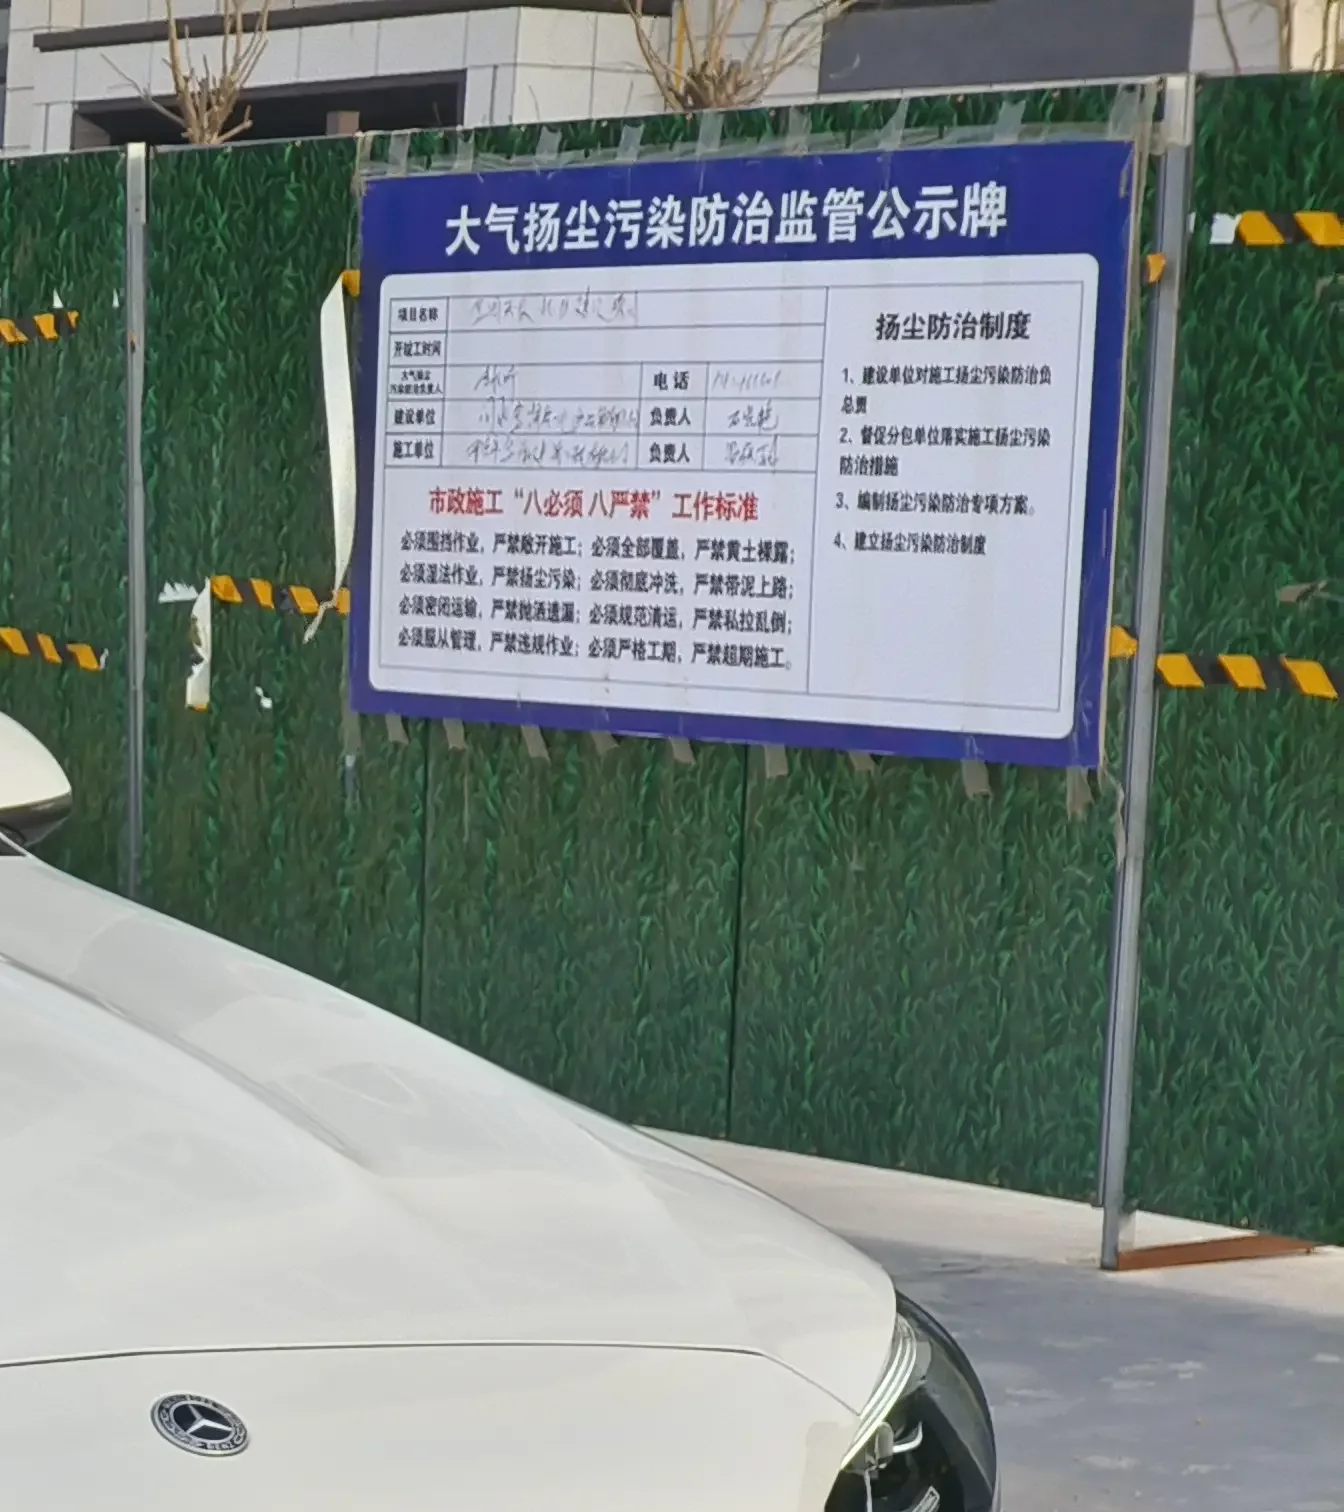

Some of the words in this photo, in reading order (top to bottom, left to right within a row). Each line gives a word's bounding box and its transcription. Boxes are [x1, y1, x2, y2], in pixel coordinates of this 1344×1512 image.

[445, 180, 1008, 256] 大气扬尘污染防治监管公示牌
[398, 307, 439, 322] 项目名称
[876, 310, 1031, 341] 扬尘防治制度
[653, 371, 689, 391] 电话
[394, 408, 436, 425] 建设单位
[650, 407, 691, 427] 负责人
[393, 439, 434, 460] 施工单位
[649, 442, 690, 463] 负责人
[839, 455, 899, 477] 防治措施
